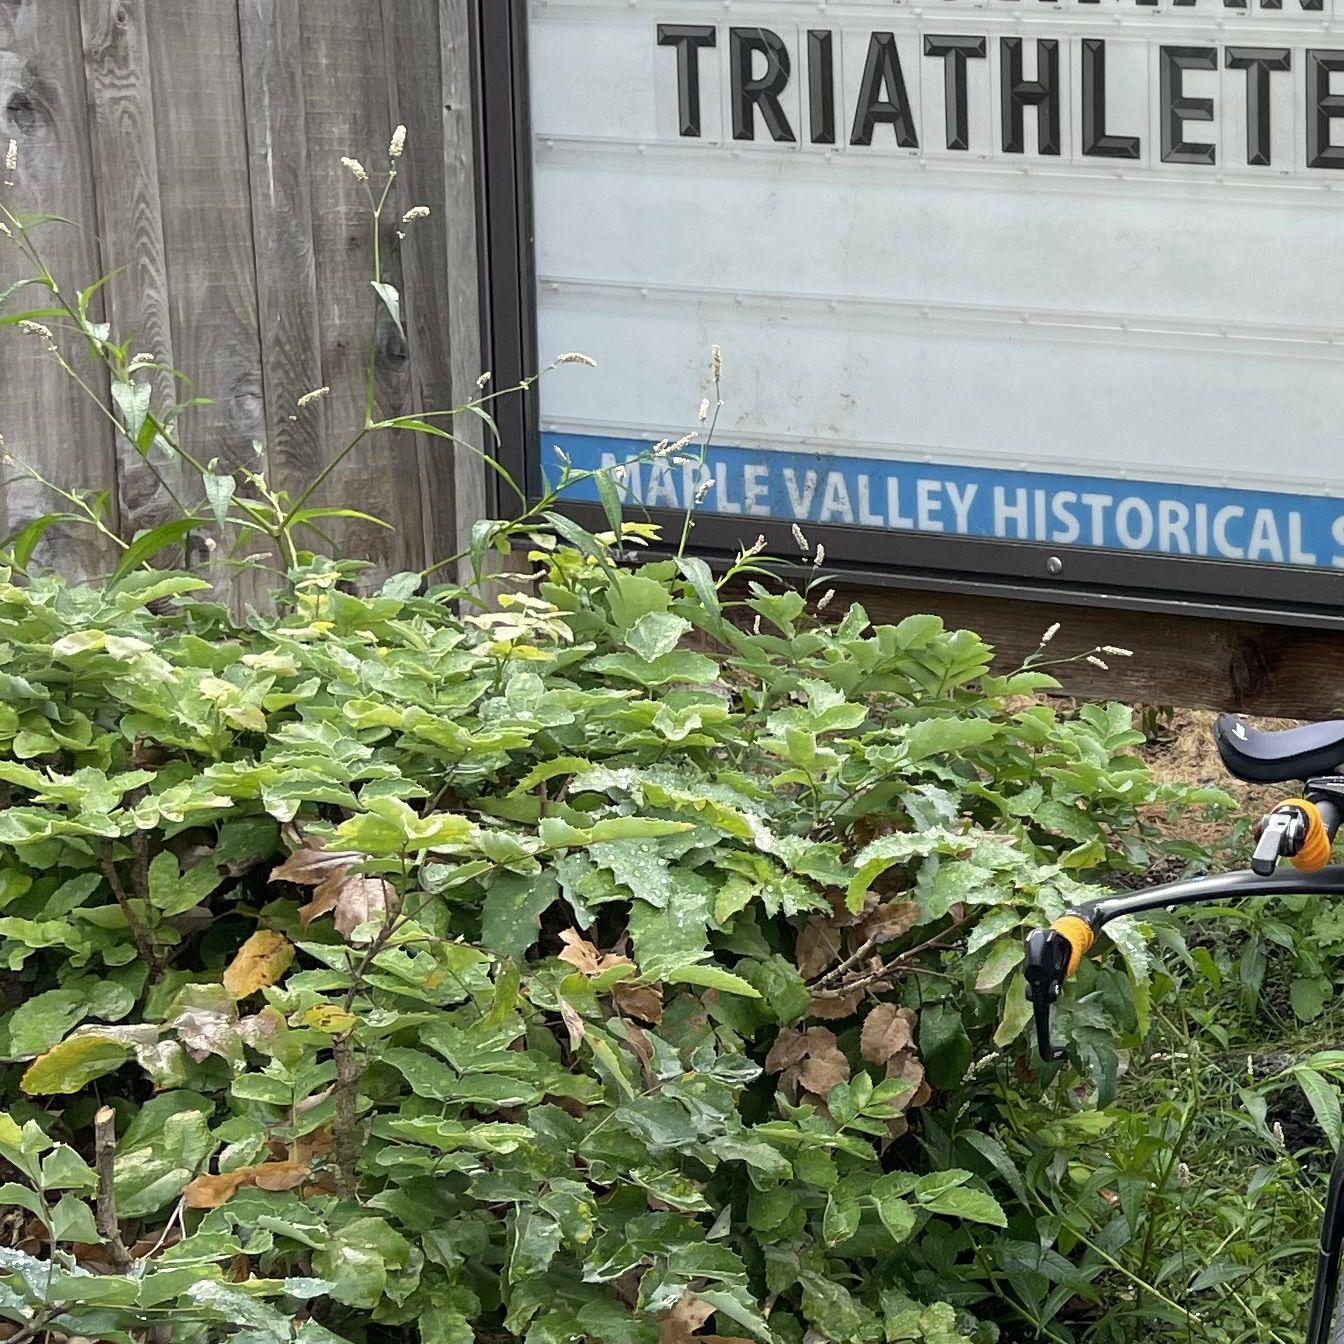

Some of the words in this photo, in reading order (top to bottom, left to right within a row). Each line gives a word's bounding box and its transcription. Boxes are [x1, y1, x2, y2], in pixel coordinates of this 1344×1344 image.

[601, 452, 771, 518] MAPLE
[783, 468, 978, 536] VALLEY
[992, 484, 1316, 565] HISTORICAL
